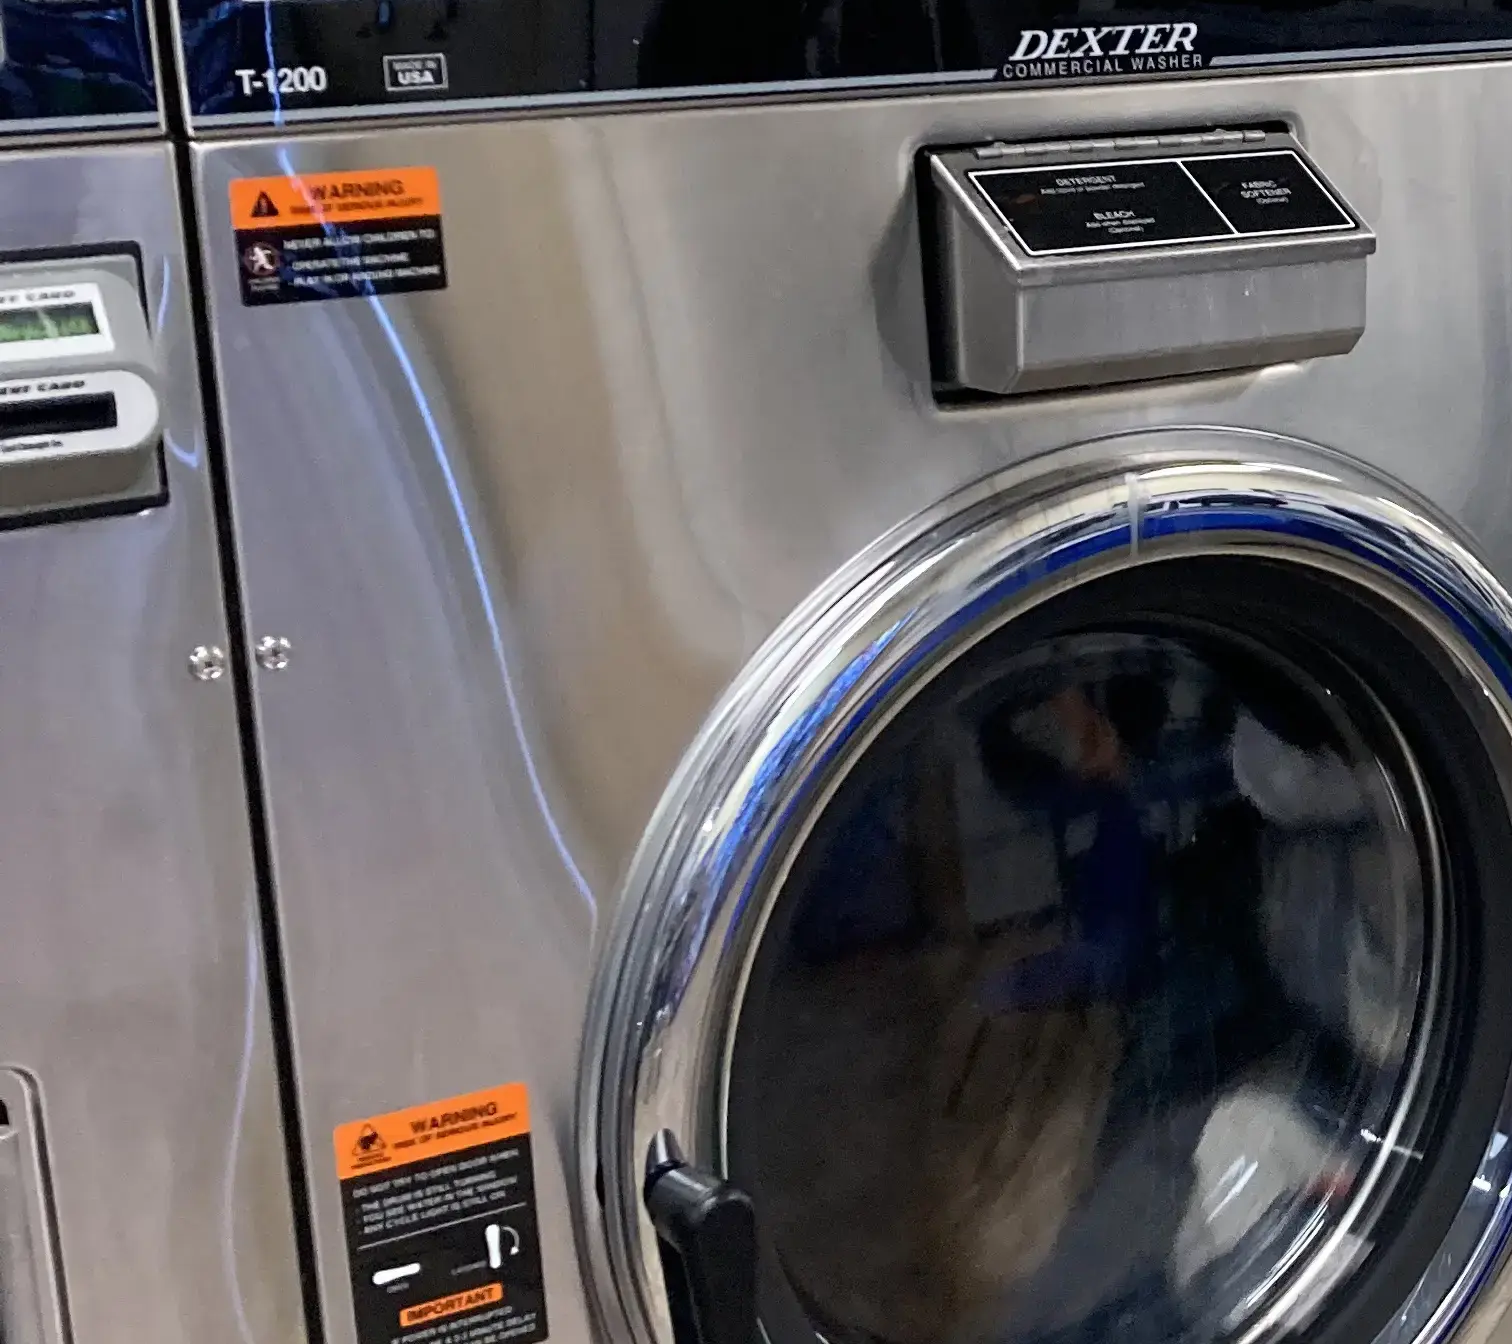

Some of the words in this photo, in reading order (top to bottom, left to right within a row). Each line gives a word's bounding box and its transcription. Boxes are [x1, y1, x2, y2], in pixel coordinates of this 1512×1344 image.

[1008, 22, 1198, 61] DEXTER
[1002, 58, 1124, 79] COMMERCIAL
[1131, 54, 1203, 71] WASHER
[235, 66, 328, 96] T-1200
[397, 70, 435, 85] USA
[1056, 175, 1117, 186] DETERGENT
[1241, 180, 1277, 189] FABRIC
[312, 180, 406, 200] WARNING
[1240, 187, 1292, 198] SOFTENER
[1093, 210, 1135, 220] BLEACH
[37, 380, 86, 393] CARD
[410, 1101, 498, 1134] WARNING
[406, 1287, 494, 1322] IMPORTANT
